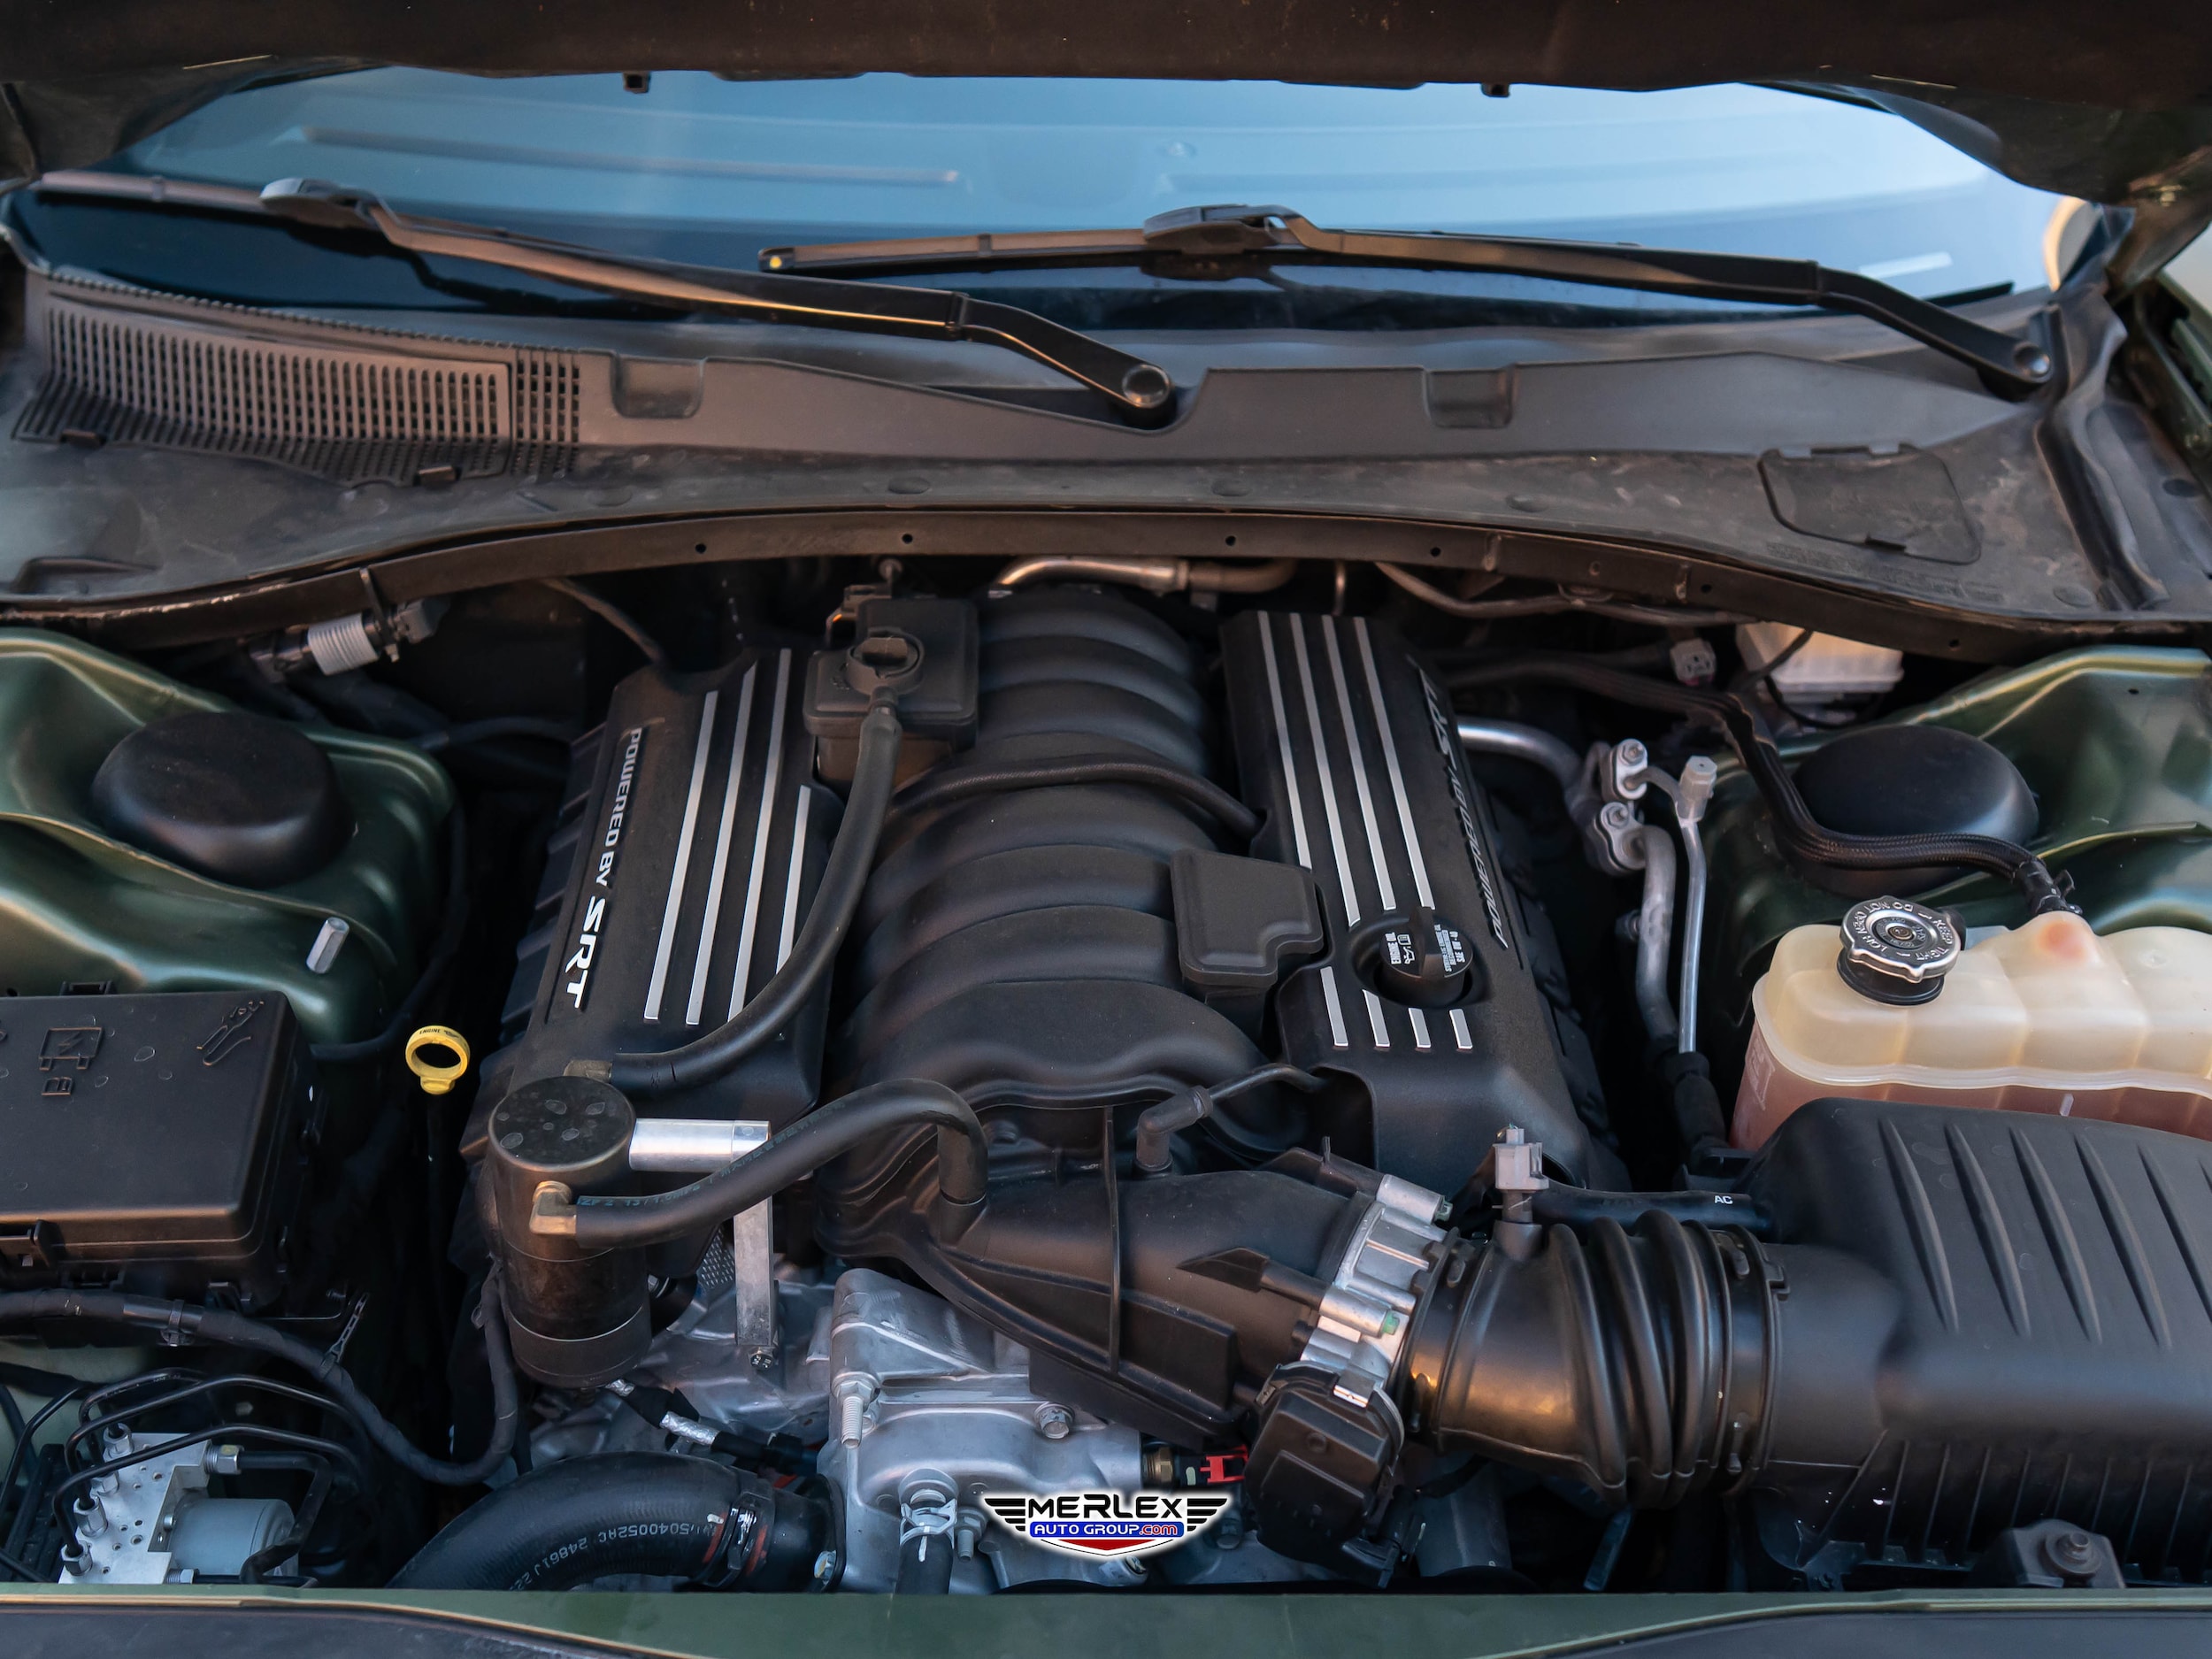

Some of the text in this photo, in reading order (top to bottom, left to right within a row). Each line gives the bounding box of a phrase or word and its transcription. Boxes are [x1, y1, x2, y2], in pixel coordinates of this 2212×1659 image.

[565, 727, 643, 1010] POWERED BY SRT
[1385, 932, 1402, 964] ENGINE OIL
[1714, 1194, 1733, 1205] AC
